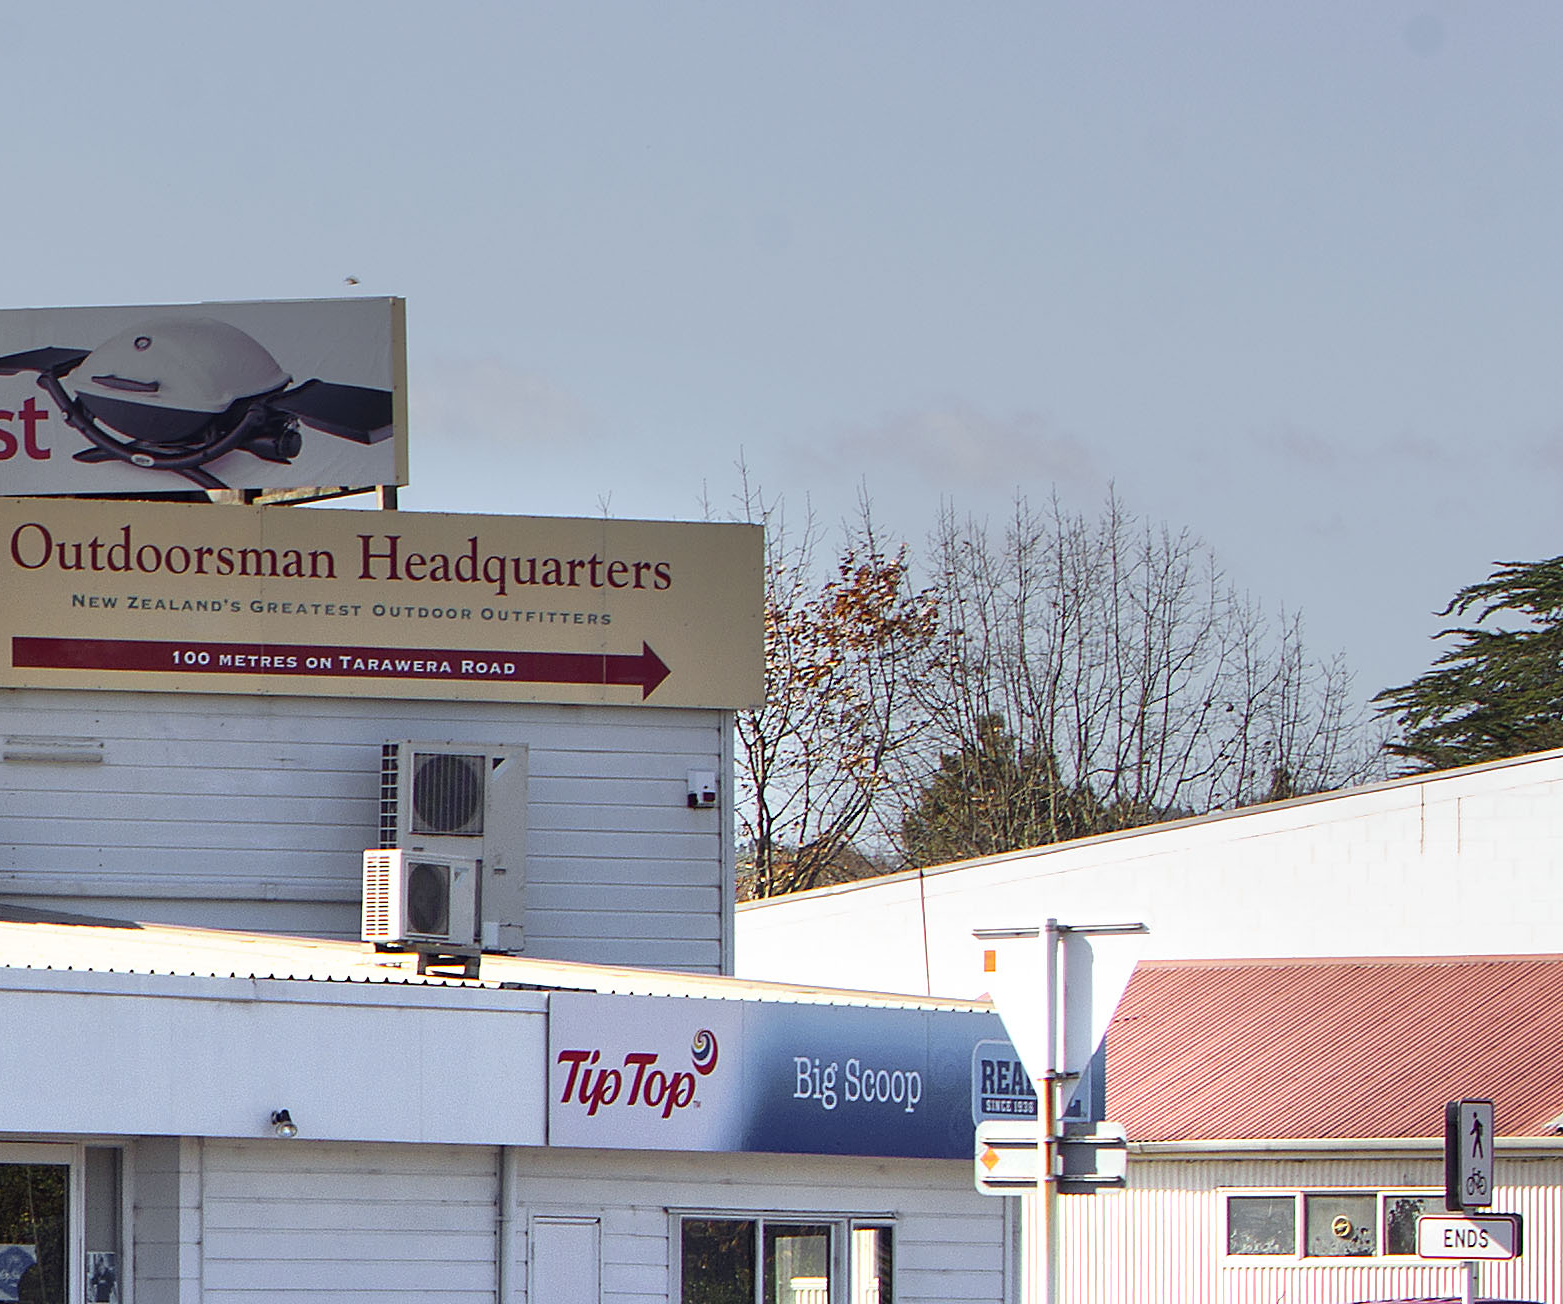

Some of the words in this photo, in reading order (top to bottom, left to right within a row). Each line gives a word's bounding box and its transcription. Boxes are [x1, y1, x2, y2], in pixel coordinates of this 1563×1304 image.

[10, 522, 338, 579] Outdoorsman
[357, 534, 672, 596] Headquarters
[72, 593, 118, 609] NEW
[127, 596, 242, 613] ZEALAND'S
[250, 600, 362, 617] GREATEST
[372, 604, 472, 620] OUTDOOR
[480, 607, 613, 625] OUTFITTERS
[172, 650, 211, 665] 100
[219, 653, 298, 669] METRES
[305, 656, 332, 669] ON
[339, 655, 452, 673] TARAWERA
[461, 660, 516, 675] ROAD
[557, 1049, 622, 1116] Tip
[623, 1053, 696, 1119] Top
[793, 1056, 838, 1111] Big
[845, 1058, 922, 1113] Scoop
[985, 1099, 1012, 1112] SINCE
[1444, 1228, 1489, 1248] ENDS
